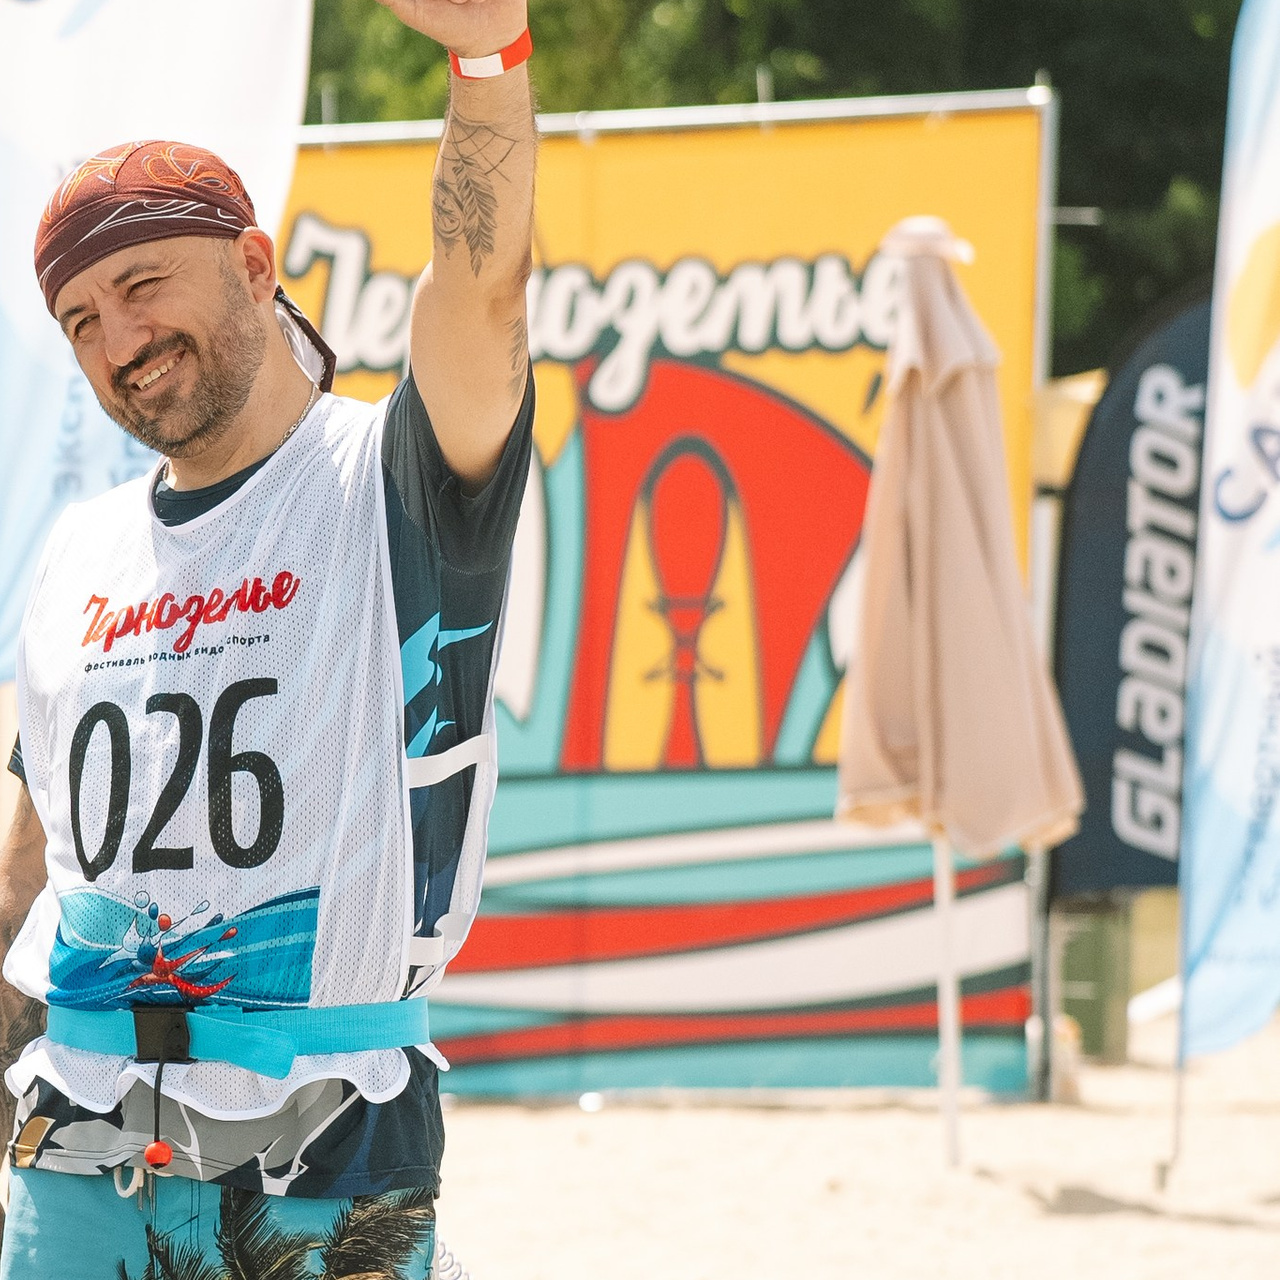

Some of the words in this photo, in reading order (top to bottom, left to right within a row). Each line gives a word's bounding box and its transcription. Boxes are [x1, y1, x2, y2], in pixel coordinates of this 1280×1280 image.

[284, 212, 910, 412] Чеоземье
[84, 657, 145, 673] фестиваль
[194, 644, 225, 657] видо
[227, 633, 271, 646] спорта
[69, 677, 285, 882] 026
